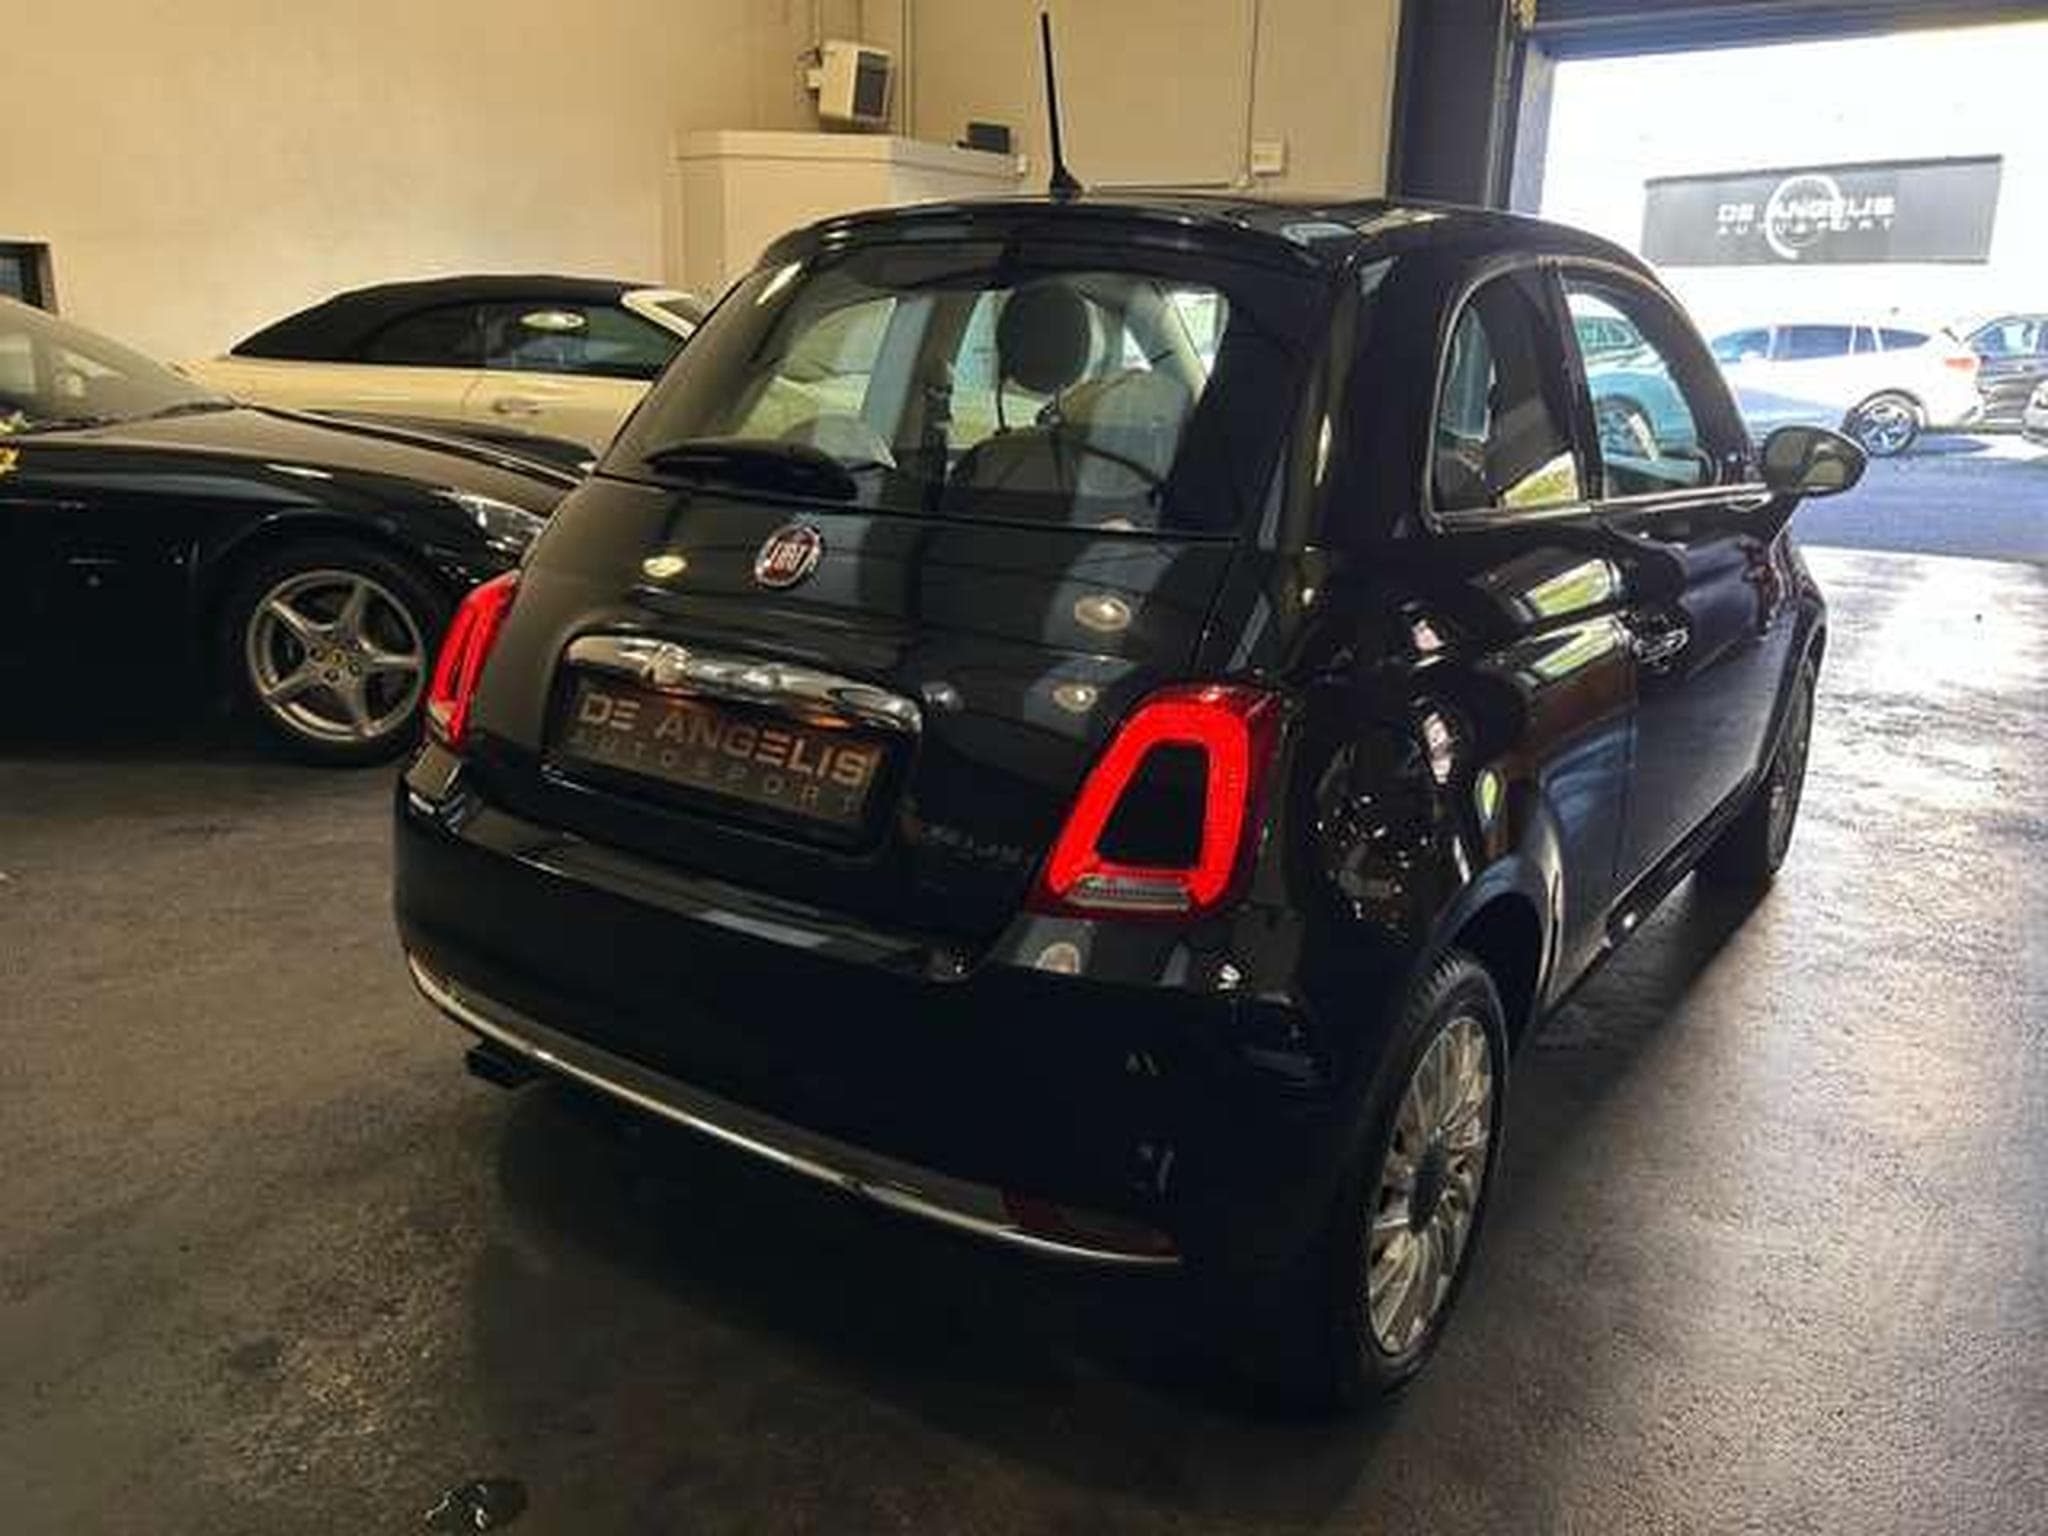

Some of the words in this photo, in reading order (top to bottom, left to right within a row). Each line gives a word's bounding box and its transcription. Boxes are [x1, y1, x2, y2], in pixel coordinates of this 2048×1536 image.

[1718, 203, 1755, 221] DE
[1770, 196, 1896, 218] ANGELIS
[579, 692, 640, 731] DE
[655, 712, 869, 787] ANGELIS
